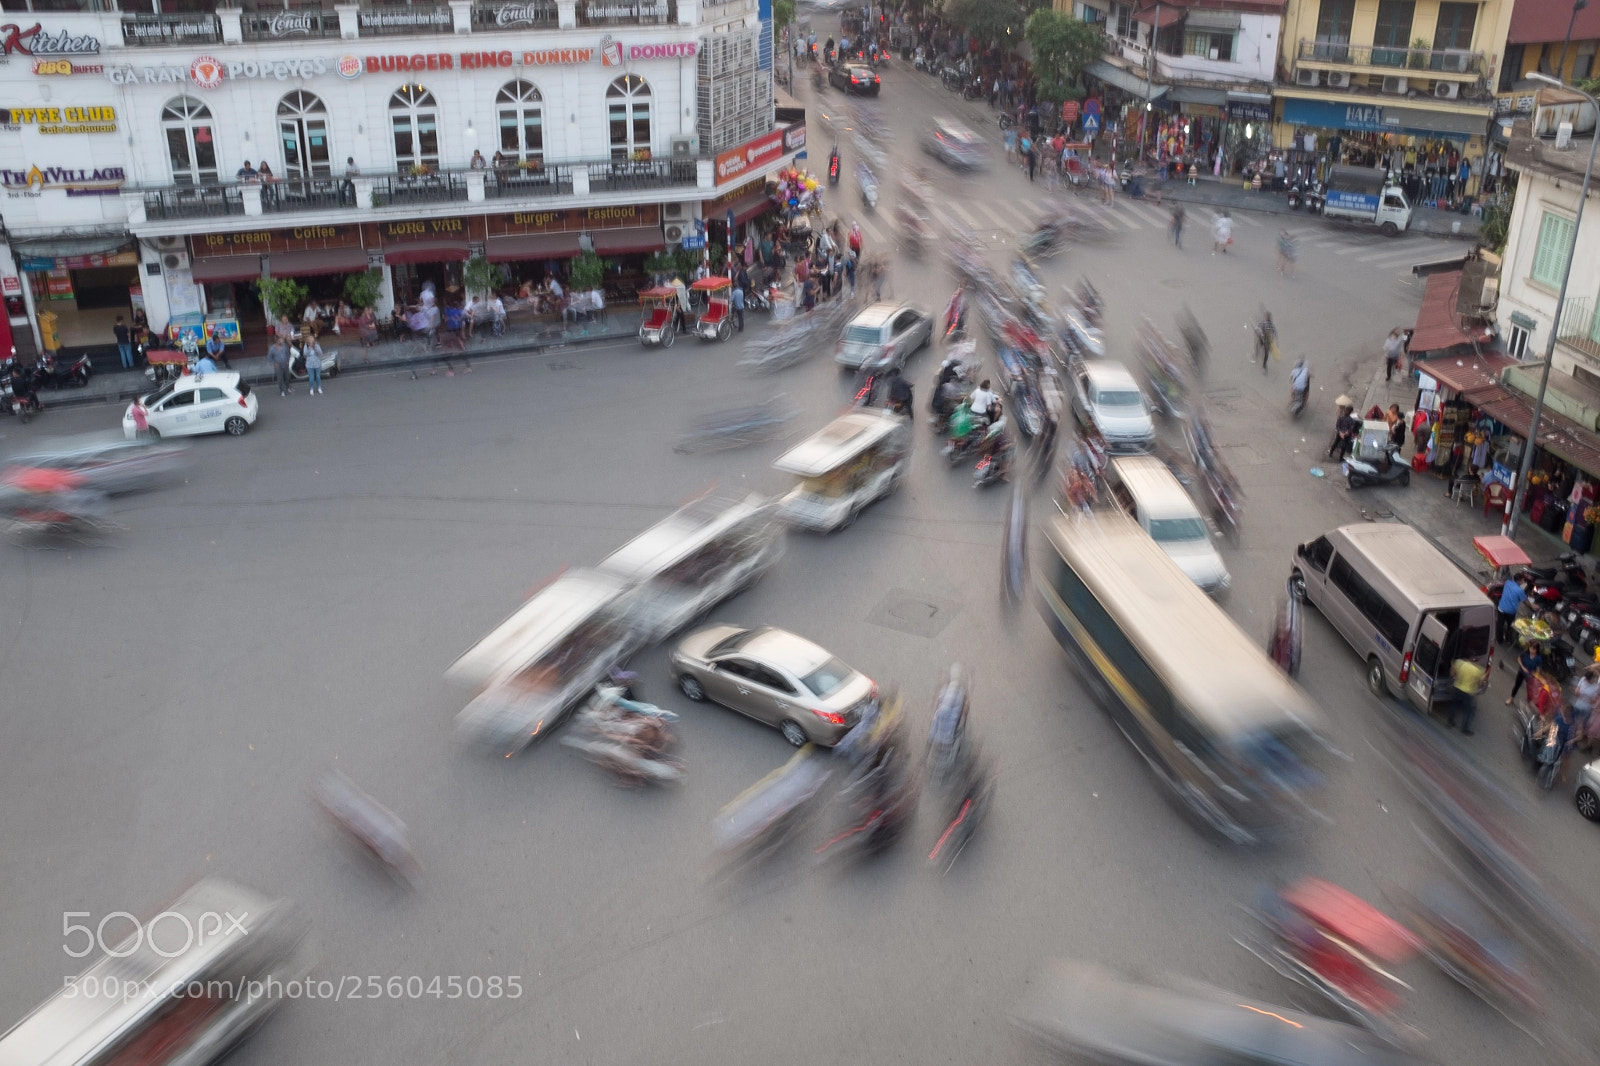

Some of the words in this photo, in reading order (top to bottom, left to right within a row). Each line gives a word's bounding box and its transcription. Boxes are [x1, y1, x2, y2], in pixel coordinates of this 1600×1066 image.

[0, 22, 100, 55] Kitchen
[523, 49, 594, 66] DUNKIN'
[630, 42, 697, 60] DONUTS
[37, 59, 72, 76] BBQ
[73, 65, 104, 74] BUFFET
[366, 52, 453, 73] BURGER
[460, 50, 513, 70] KING
[64, 106, 116, 122] CLUB
[514, 212, 554, 226] Burger
[588, 205, 636, 219] Fastfood
[233, 231, 271, 244] cream
[294, 226, 336, 239] Coffee
[388, 220, 426, 235] LONG
